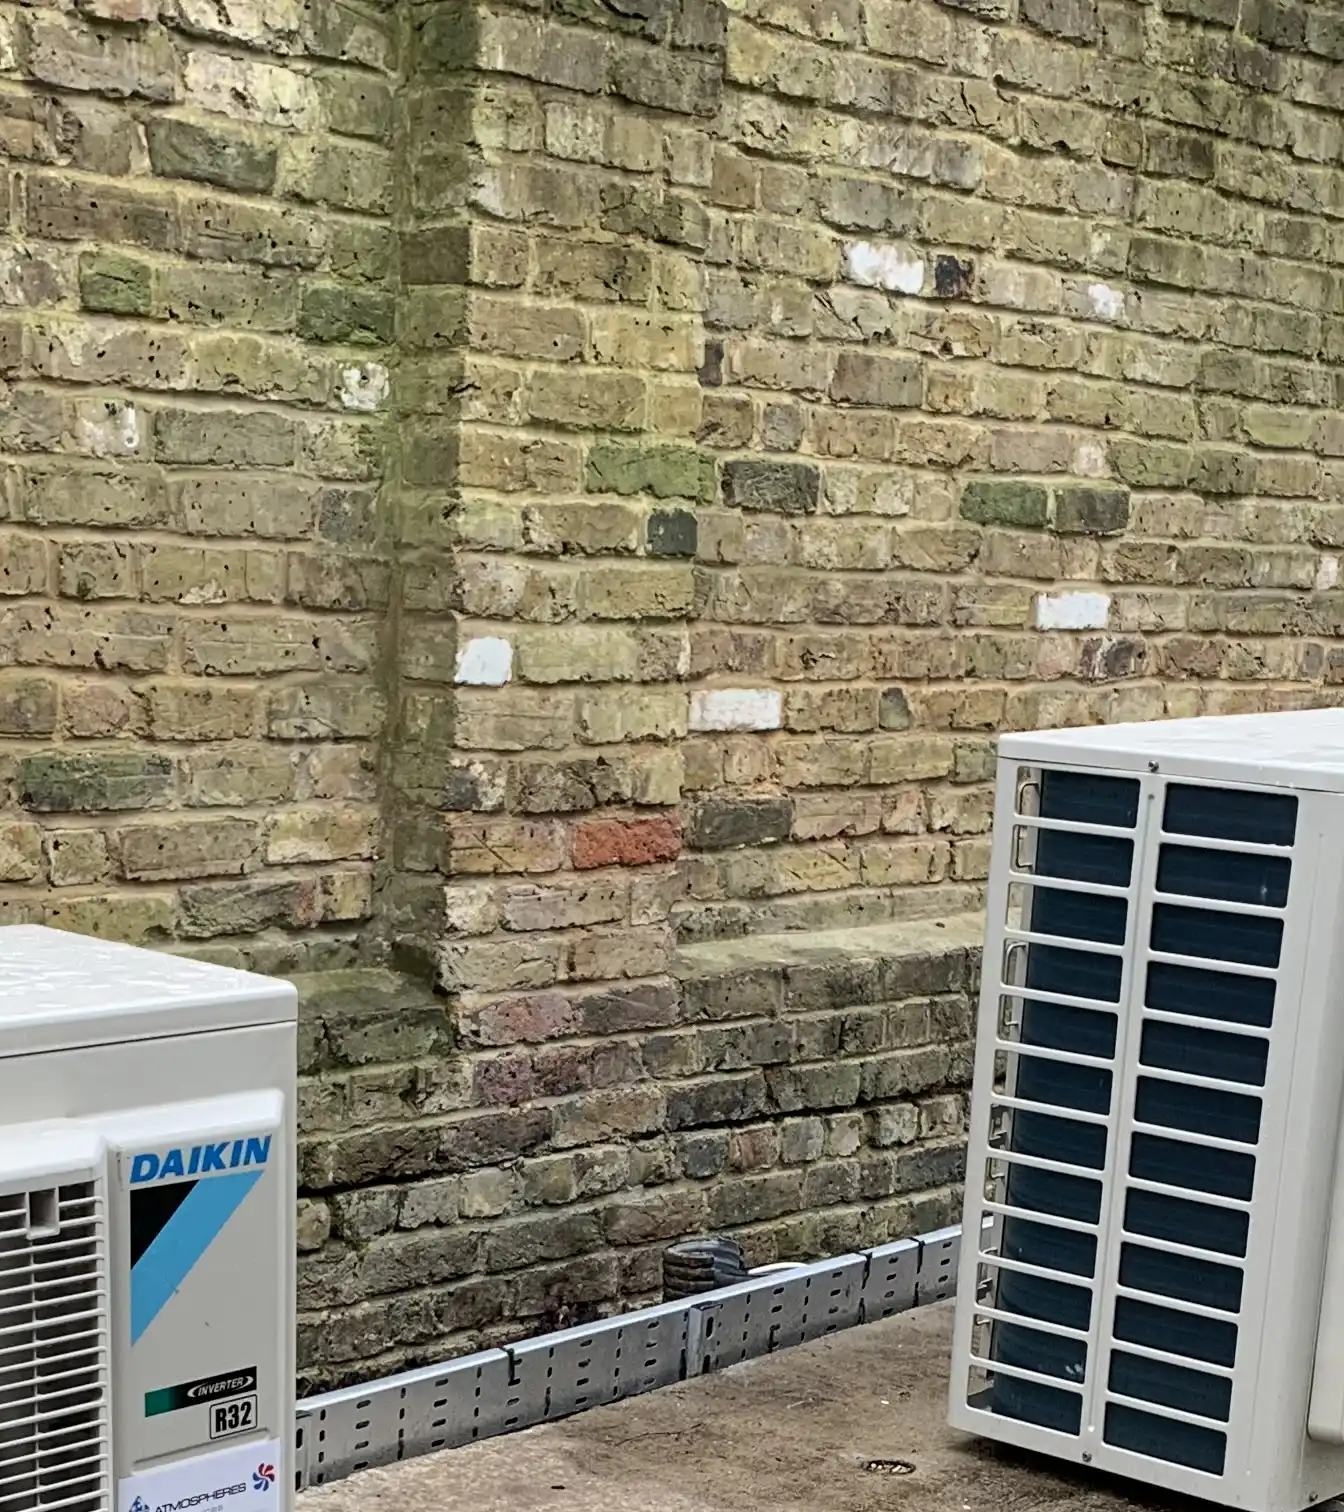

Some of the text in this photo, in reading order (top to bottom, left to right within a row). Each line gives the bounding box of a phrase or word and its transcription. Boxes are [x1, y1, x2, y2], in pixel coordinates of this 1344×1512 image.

[129, 1133, 272, 1184] DAIKIN
[197, 1376, 244, 1397] INVERTER
[215, 1401, 253, 1433] R32
